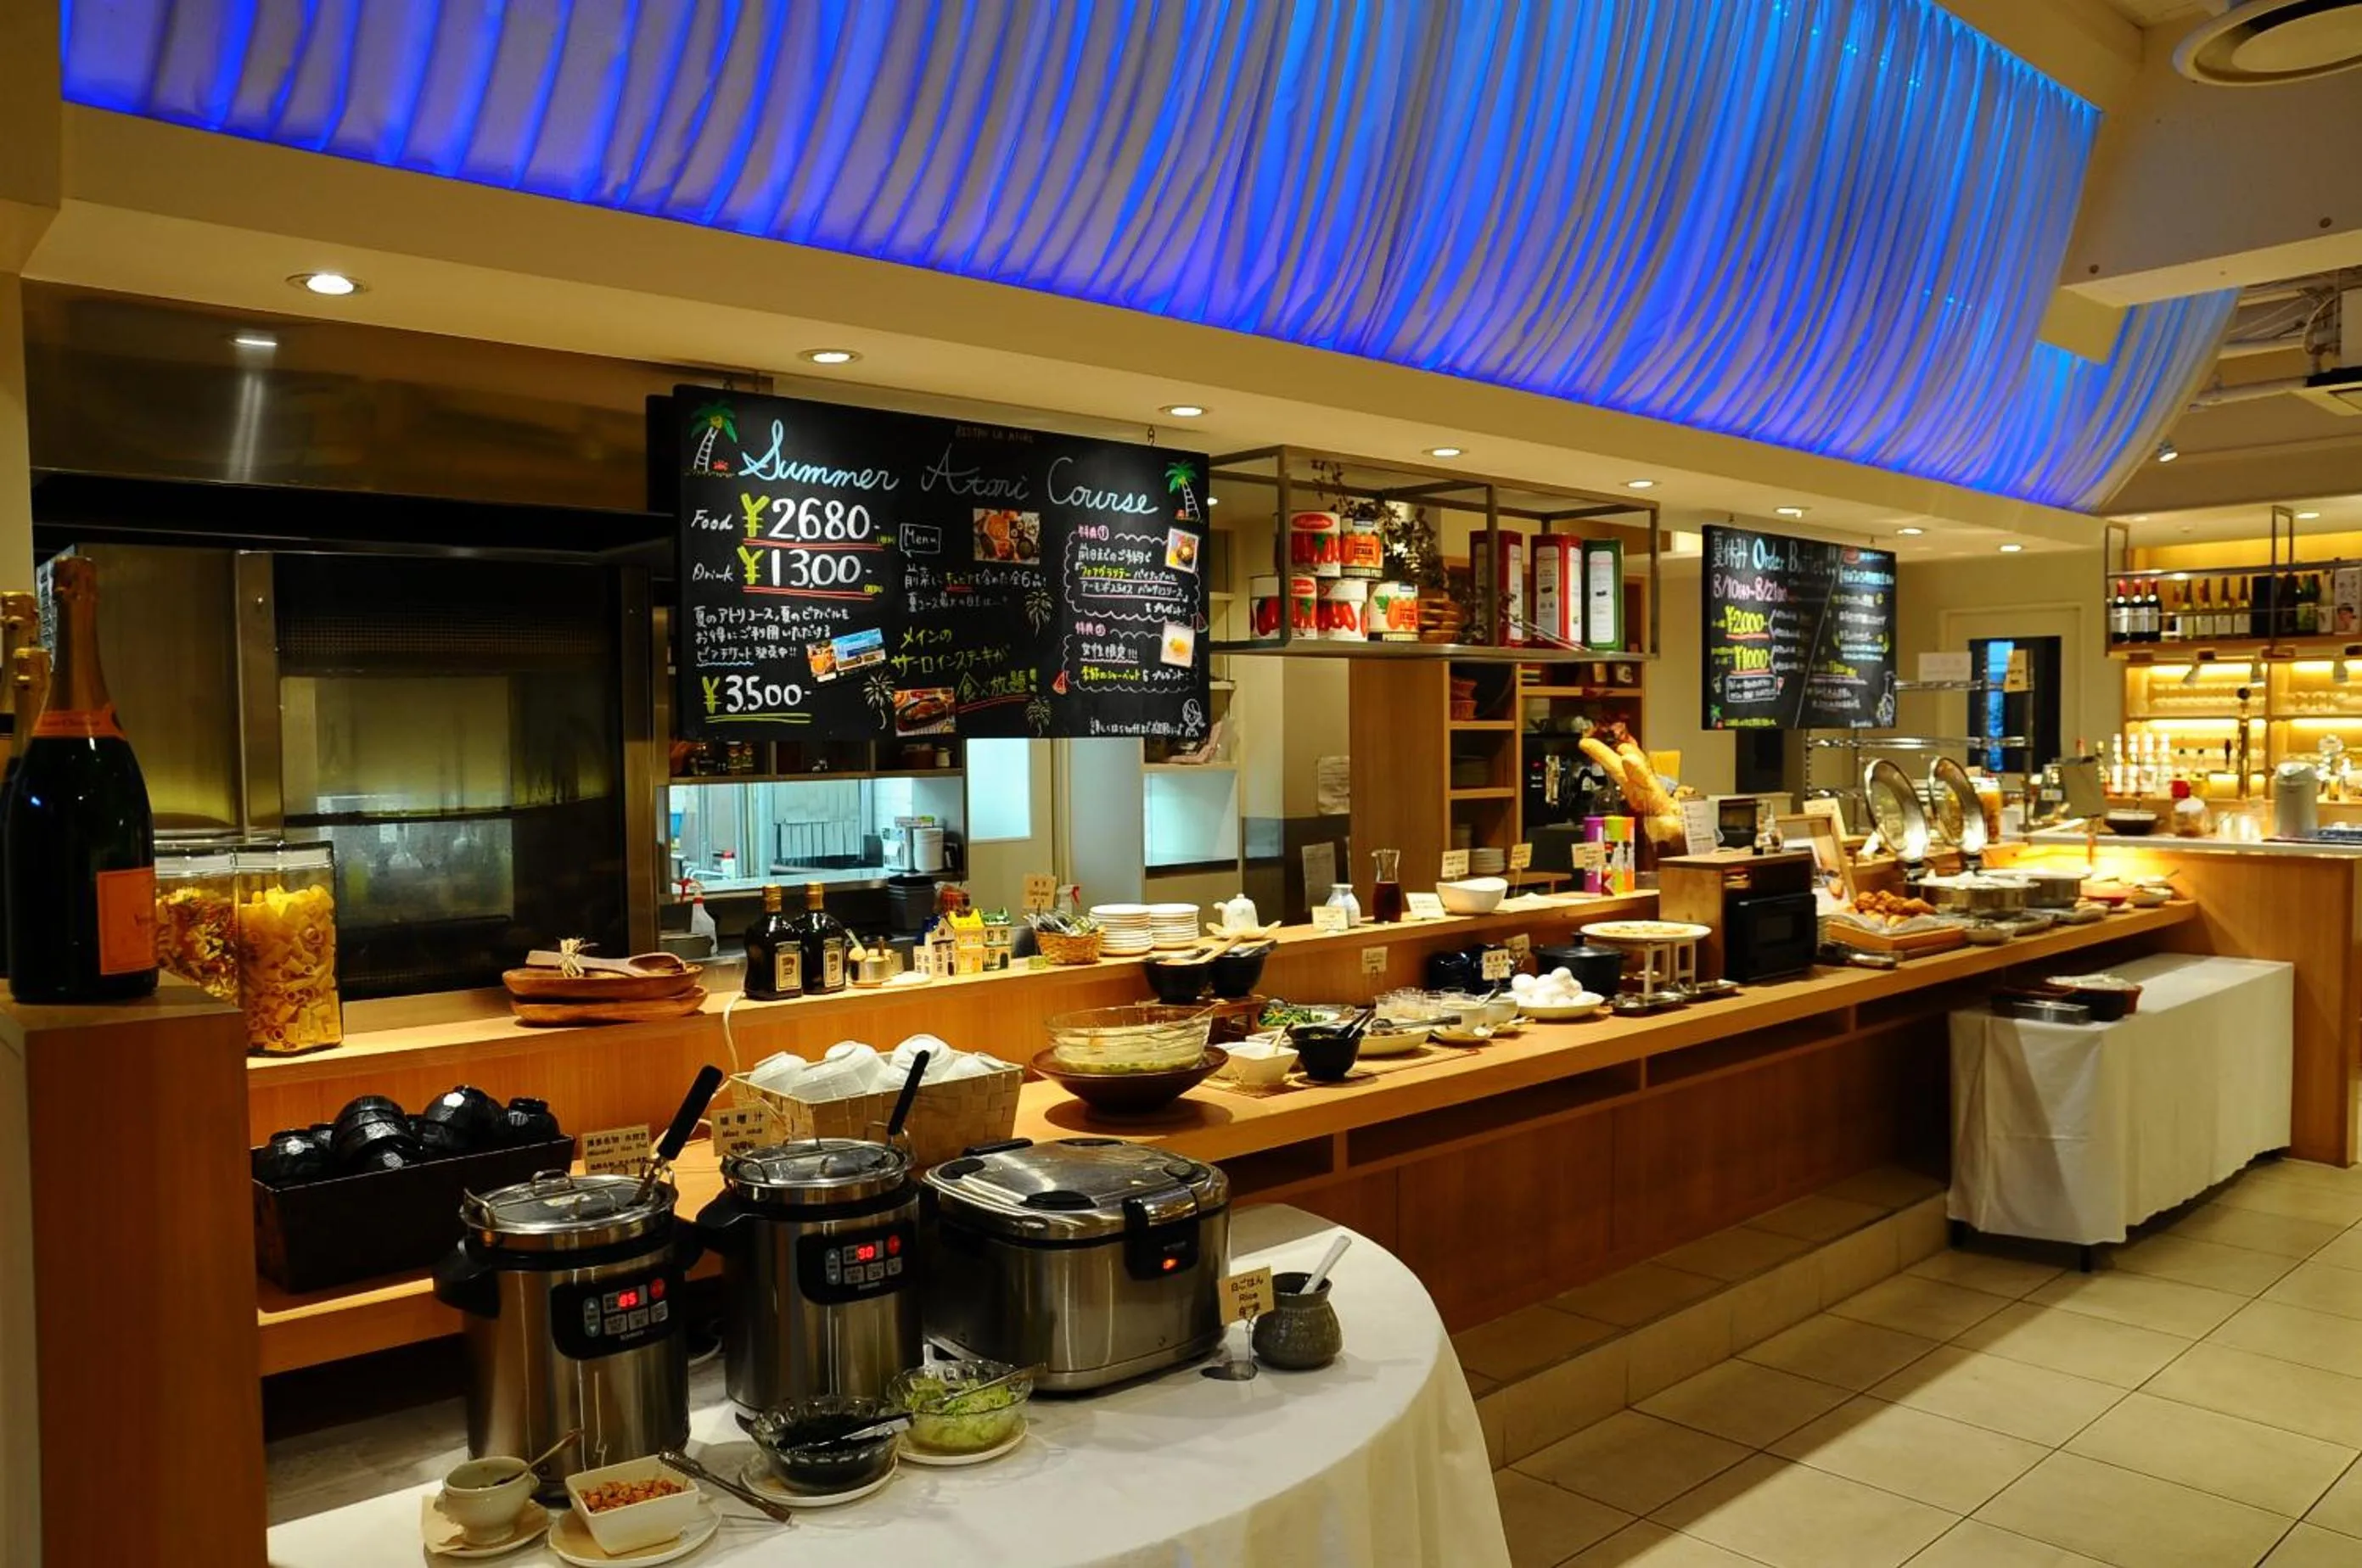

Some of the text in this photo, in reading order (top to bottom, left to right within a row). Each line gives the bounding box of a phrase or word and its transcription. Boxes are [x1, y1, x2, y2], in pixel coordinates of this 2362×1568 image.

[738, 419, 899, 490] Summer
[1047, 456, 1159, 514] Course
[691, 509, 733, 529] Food
[693, 563, 733, 582] Drink
[900, 626, 951, 648] メインの
